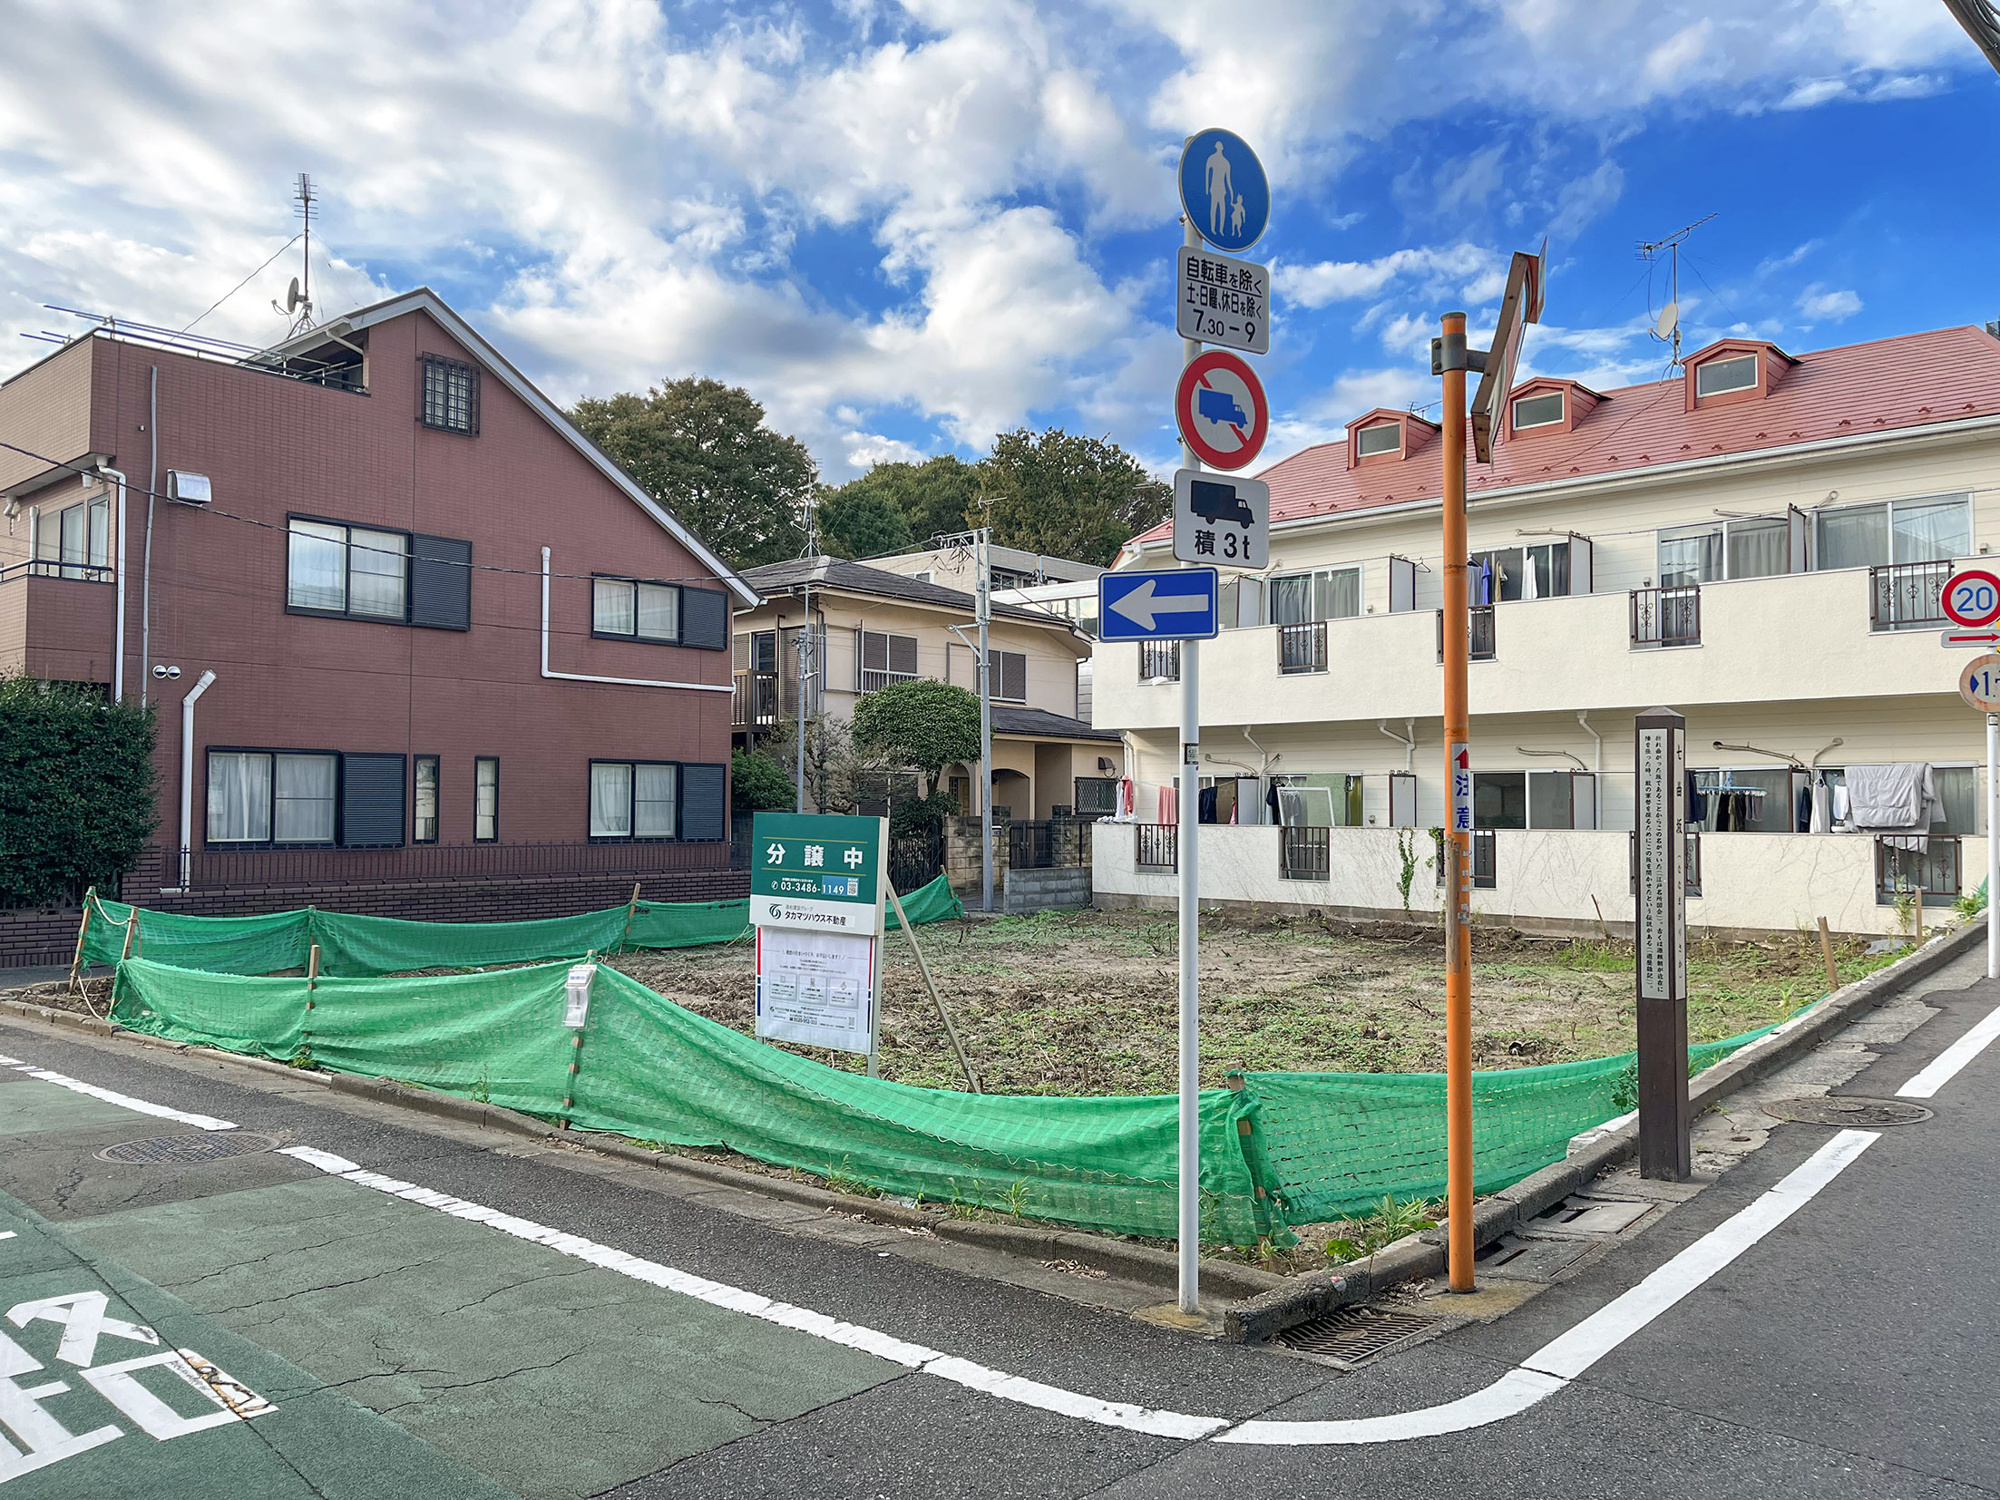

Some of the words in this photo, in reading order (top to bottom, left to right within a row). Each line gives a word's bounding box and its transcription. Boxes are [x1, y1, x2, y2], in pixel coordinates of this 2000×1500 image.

[1187, 256, 1262, 294] 自転車を除く
[1956, 587, 1993, 612] 20
[1983, 671, 2000, 697] 1.
[766, 843, 863, 870] 分譲中
[780, 881, 845, 895] 03-3486-1149
[785, 911, 847, 926] タカマツハウス不動産
